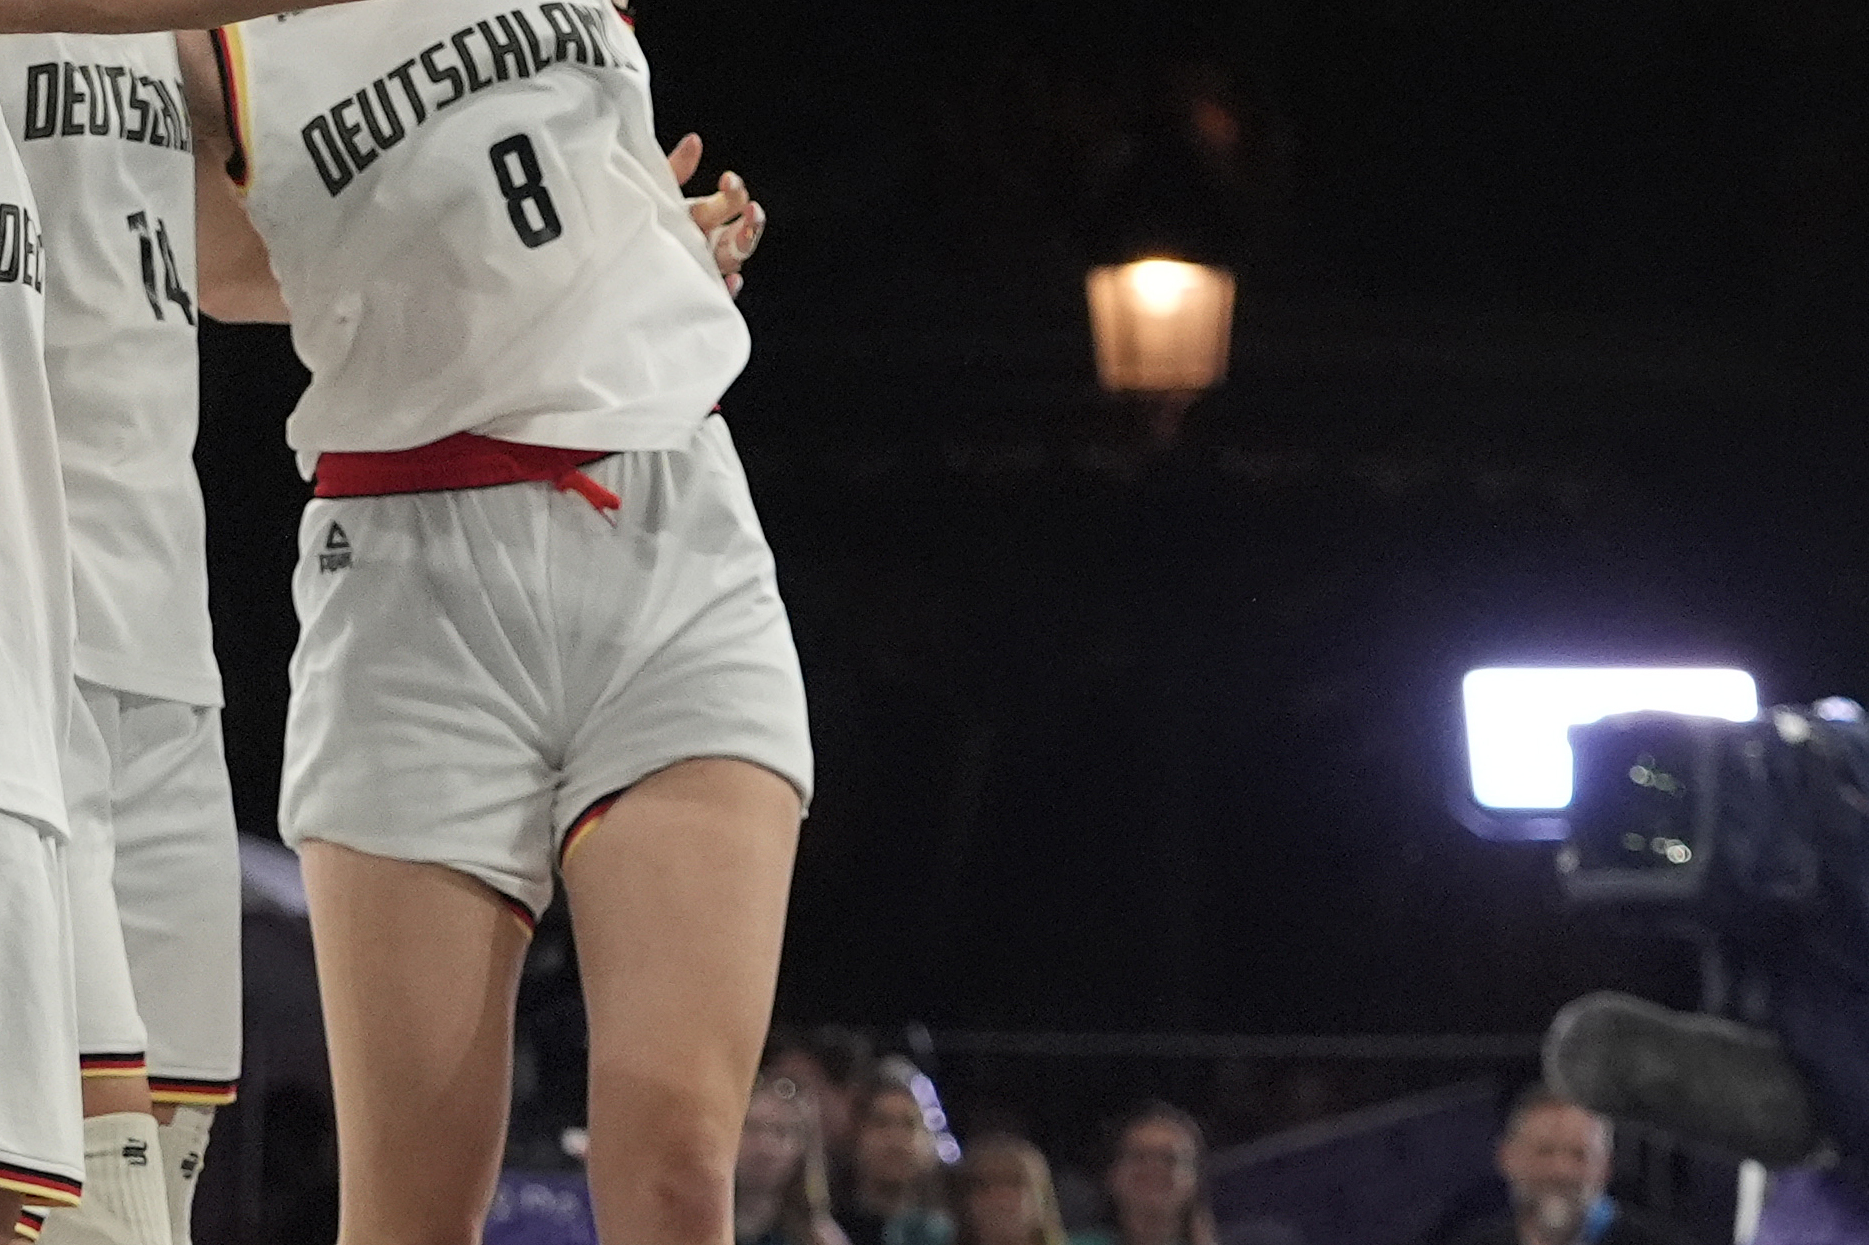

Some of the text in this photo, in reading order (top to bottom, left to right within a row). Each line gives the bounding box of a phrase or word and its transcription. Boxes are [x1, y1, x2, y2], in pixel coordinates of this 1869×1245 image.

[300, 2, 638, 198] DEUTSCHLAN
[489, 132, 562, 249] 8
[127, 210, 195, 326] 14
